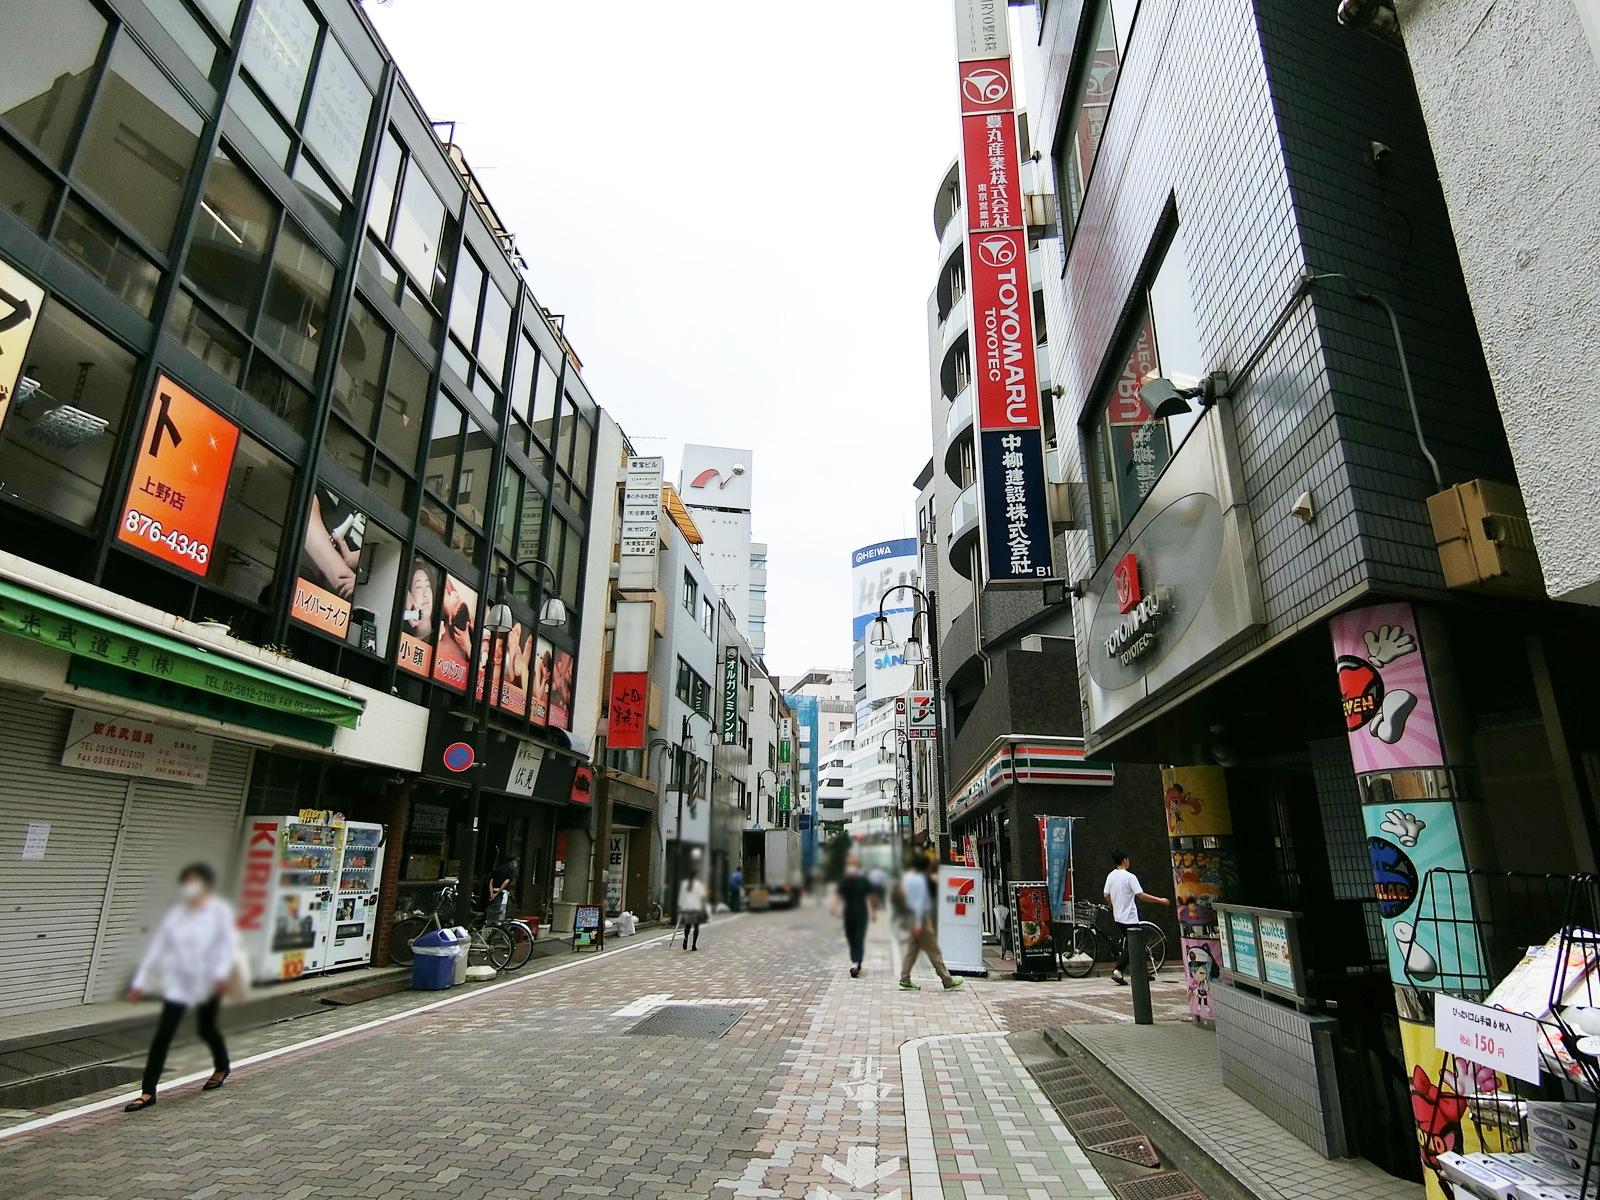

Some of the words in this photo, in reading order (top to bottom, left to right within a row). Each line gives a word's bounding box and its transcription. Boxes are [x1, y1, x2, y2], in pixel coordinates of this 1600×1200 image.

[977, 183, 989, 228] 東京営業所
[984, 307, 1001, 382] TOYOTEC
[997, 267, 1028, 424] TOYOMARU
[149, 392, 182, 457] ト
[140, 476, 186, 511] 上野店
[1001, 433, 1033, 574] 中柳建設株式会社
[126, 510, 209, 564] 876-4343
[862, 546, 892, 559] HEIWA
[1036, 565, 1051, 577] B1
[0, 604, 174, 675] 光武道具(株)
[1104, 592, 1160, 659] TOYOMARU
[1120, 633, 1151, 667] TOYOTEC
[400, 641, 425, 667] 小顔
[724, 659, 737, 742] オルガンミシン針
[77, 753, 91, 763] FAX
[81, 741, 94, 751] TEL
[236, 822, 278, 930] KIRIN
